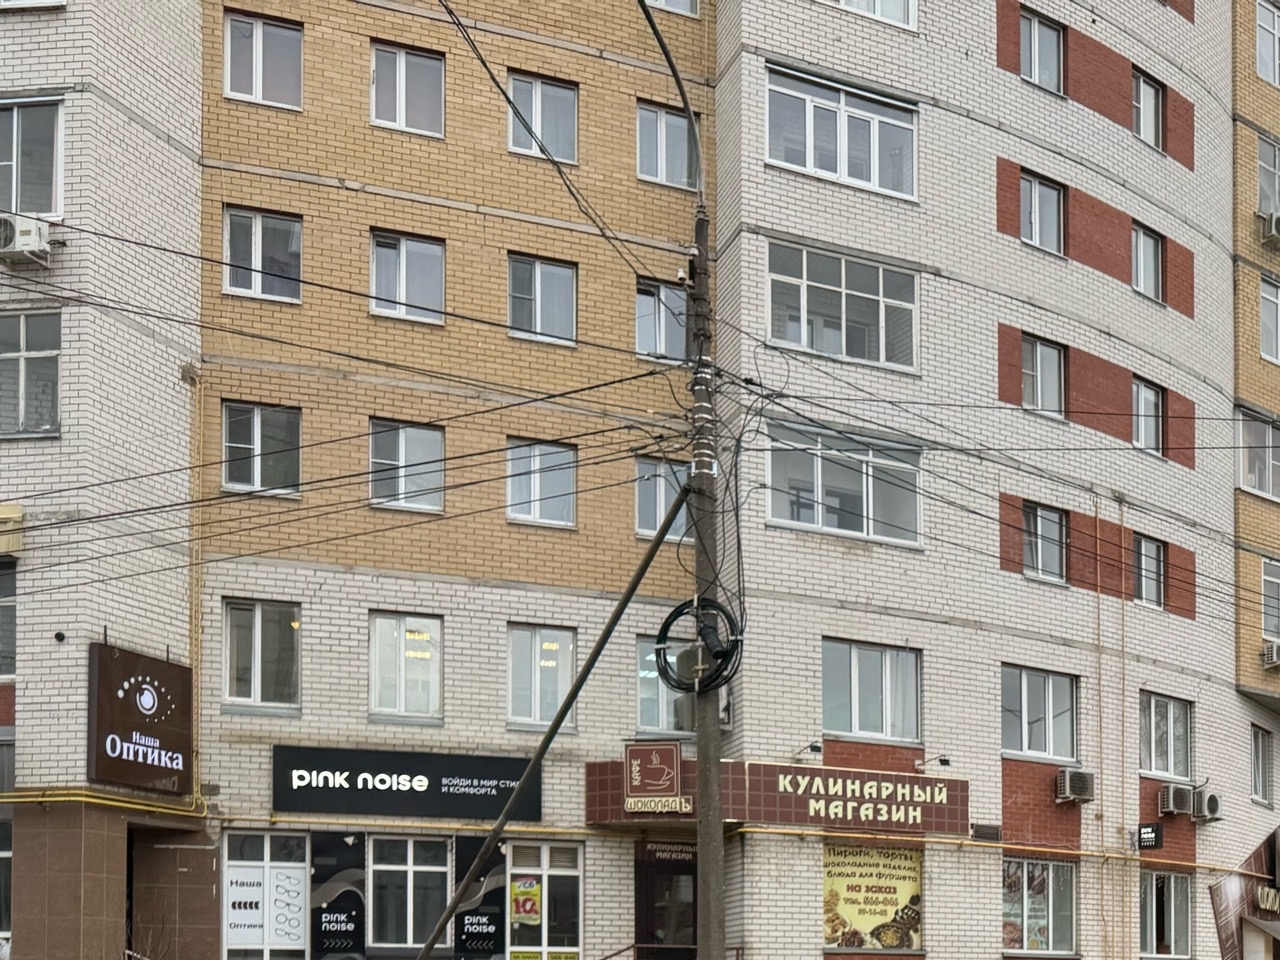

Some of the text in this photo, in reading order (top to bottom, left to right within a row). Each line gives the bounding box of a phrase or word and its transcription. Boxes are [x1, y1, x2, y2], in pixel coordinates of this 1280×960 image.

[132, 731, 160, 748] Наша
[105, 733, 184, 771] Оптика
[631, 758, 641, 786] КАФЕ
[291, 769, 429, 792] pink noise
[441, 776, 472, 787] ВОЙДИ
[480, 779, 498, 788] МИР
[441, 786, 497, 796] И КОМФОРТА
[778, 774, 948, 804] КУЛИНАРНЫЙ
[809, 799, 922, 825] МАГАЗИН
[647, 843, 698, 852] КУЛИНАРНЫ
[828, 848, 915, 863] Пироги, торты,
[827, 870, 857, 878] блюда
[230, 879, 262, 888] Наша
